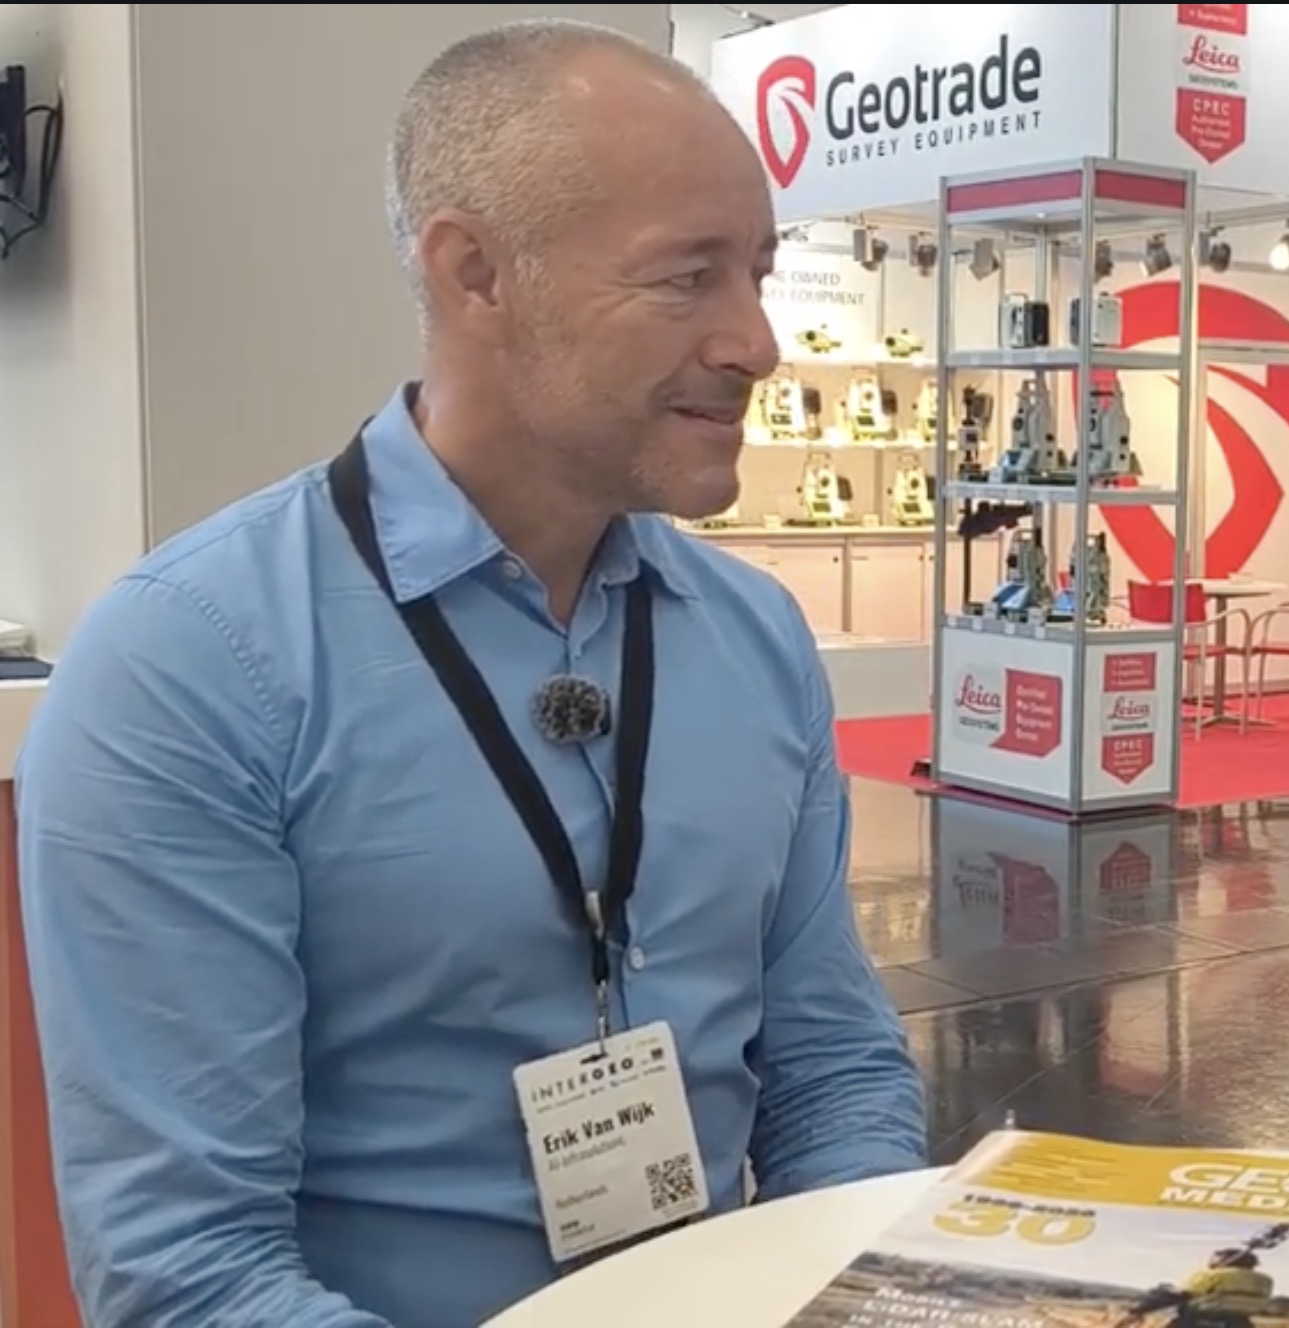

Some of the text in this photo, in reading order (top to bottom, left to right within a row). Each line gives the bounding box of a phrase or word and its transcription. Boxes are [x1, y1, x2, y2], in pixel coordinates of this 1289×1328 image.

[1182, 34, 1240, 73] Leica
[826, 34, 1042, 140] Geotrade
[826, 111, 1041, 167] SURVEY EQUIPMENT
[954, 675, 1002, 714] Leica
[1106, 696, 1151, 720] Leica
[531, 1057, 634, 1103] INTERGEO
[543, 1101, 655, 1154] Erik Van Wijk
[933, 1199, 1096, 1245] 30
